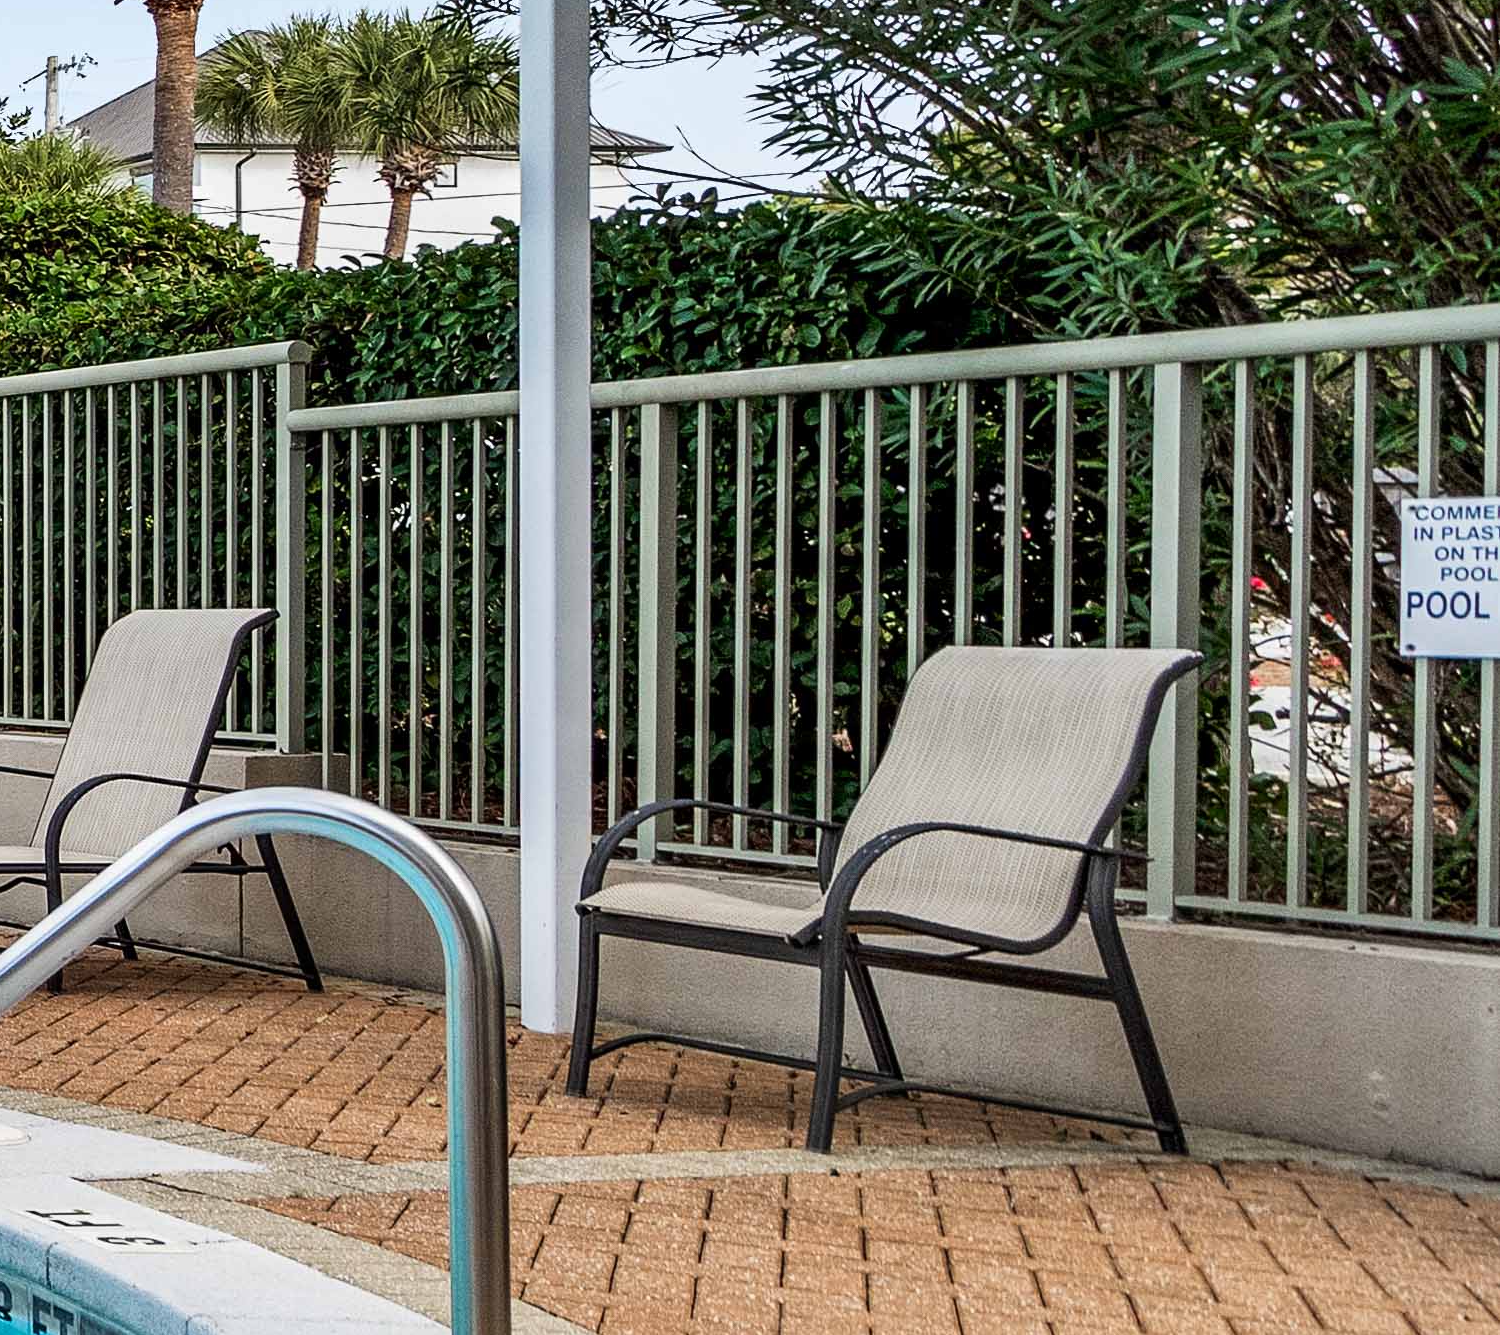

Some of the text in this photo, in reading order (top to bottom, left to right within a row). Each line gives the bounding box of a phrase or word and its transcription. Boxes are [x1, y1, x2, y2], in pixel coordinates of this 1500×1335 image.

[1415, 505, 1500, 521] COMME
[1414, 526, 1434, 541] IN
[1434, 546, 1465, 561] ON
[1440, 566, 1499, 582] POOL
[1406, 590, 1491, 619] POOL
